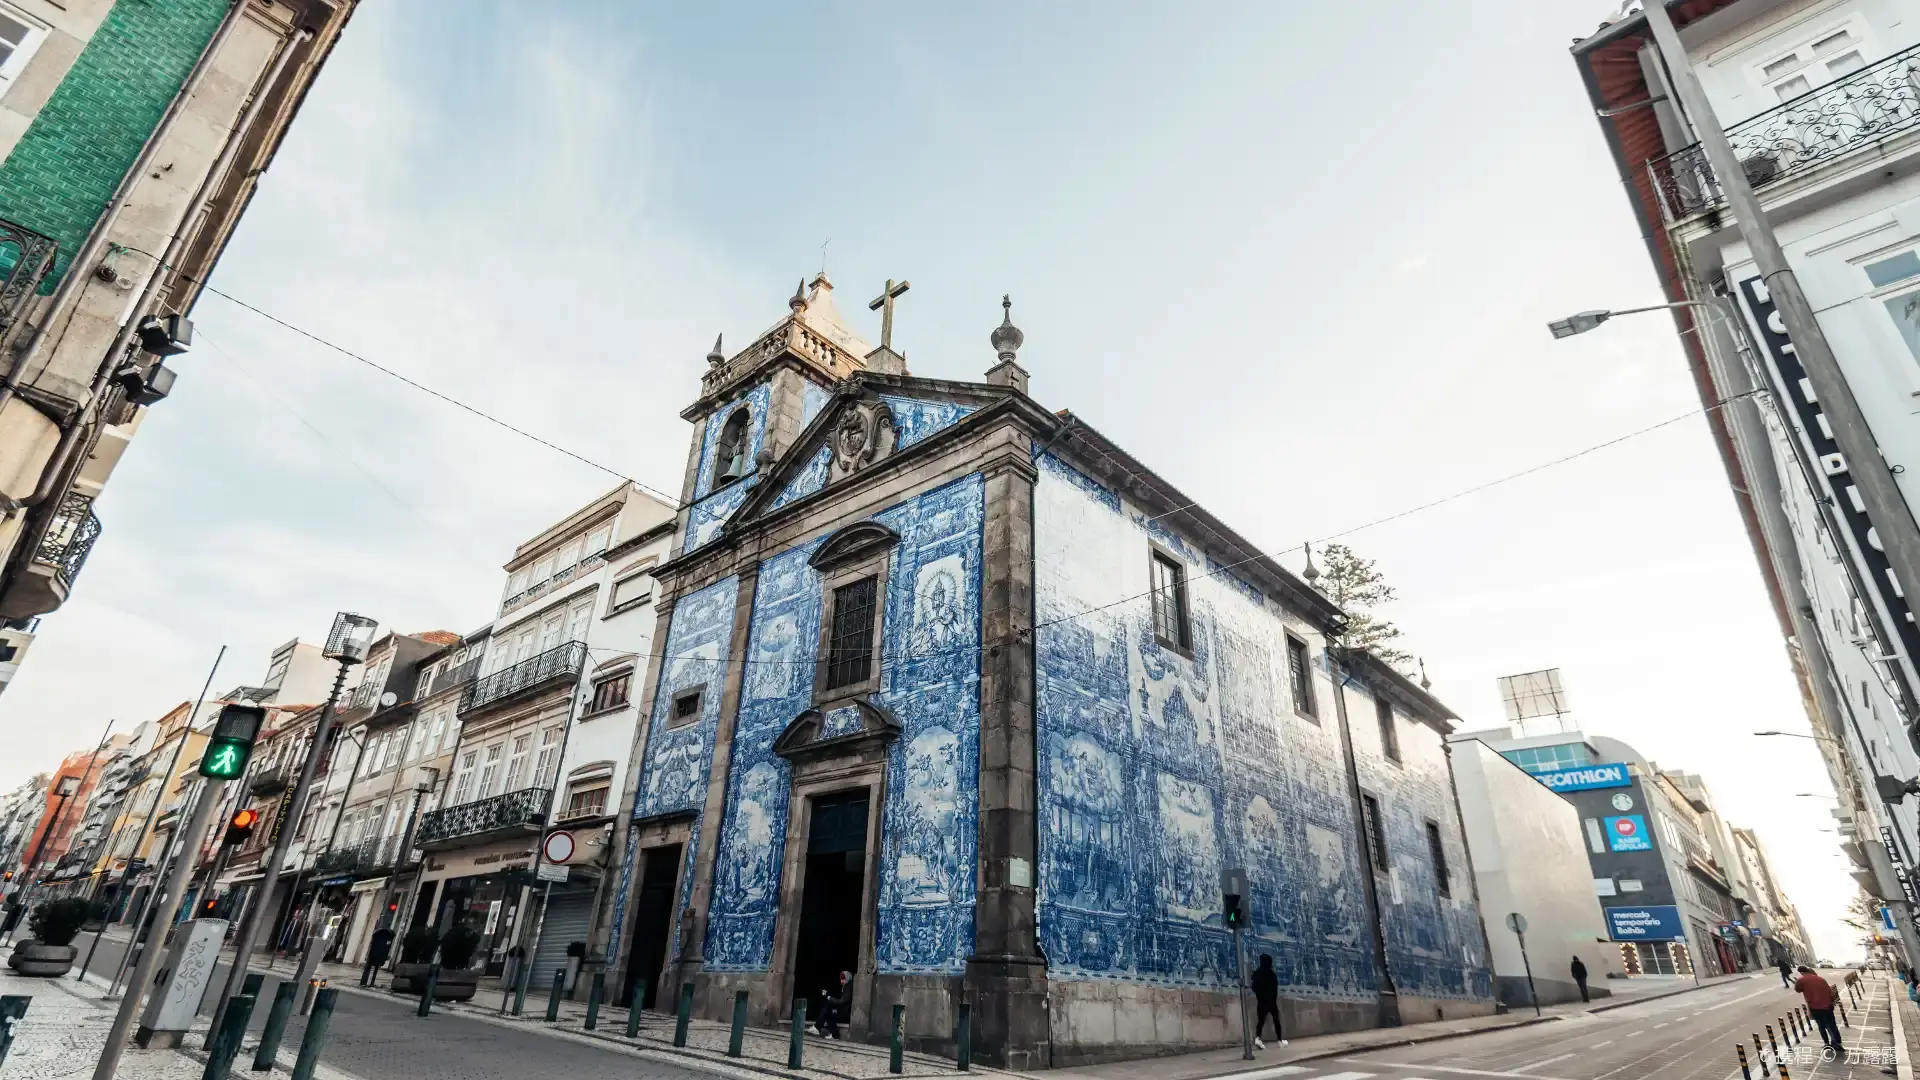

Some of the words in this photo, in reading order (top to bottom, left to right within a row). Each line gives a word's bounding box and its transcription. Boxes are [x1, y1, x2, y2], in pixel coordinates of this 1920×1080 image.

[1535, 766, 1622, 788] DECATHLON
[1613, 911, 1650, 919] mercado
[1614, 918, 1661, 927] temporário
